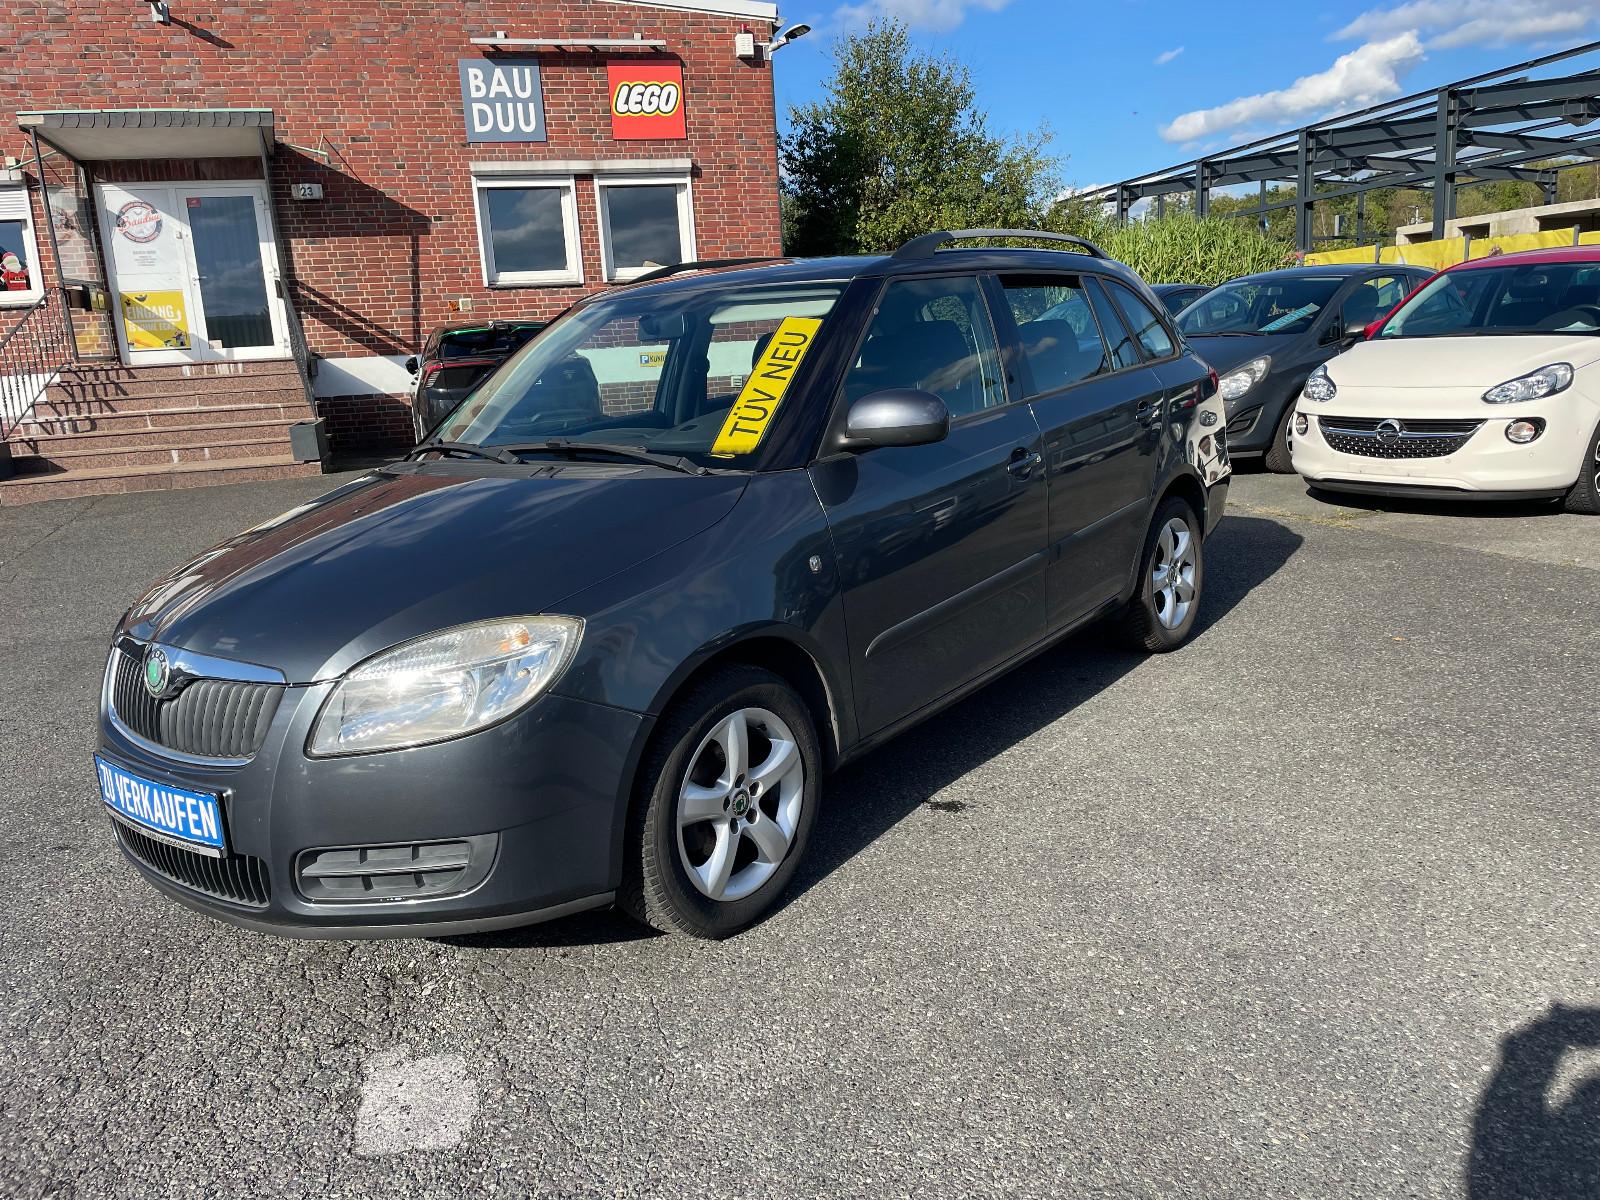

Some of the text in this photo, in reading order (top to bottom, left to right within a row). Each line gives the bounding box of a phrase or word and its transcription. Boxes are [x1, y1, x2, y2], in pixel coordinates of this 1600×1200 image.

[467, 67, 532, 99] BAU
[615, 83, 680, 115] LEGO
[471, 102, 537, 133] DUU
[300, 186, 313, 197] 23
[126, 304, 175, 319] EINGANG
[729, 331, 809, 437] TÜV NEU
[99, 763, 116, 803] ZU
[114, 772, 218, 840] VERKAUFEN
